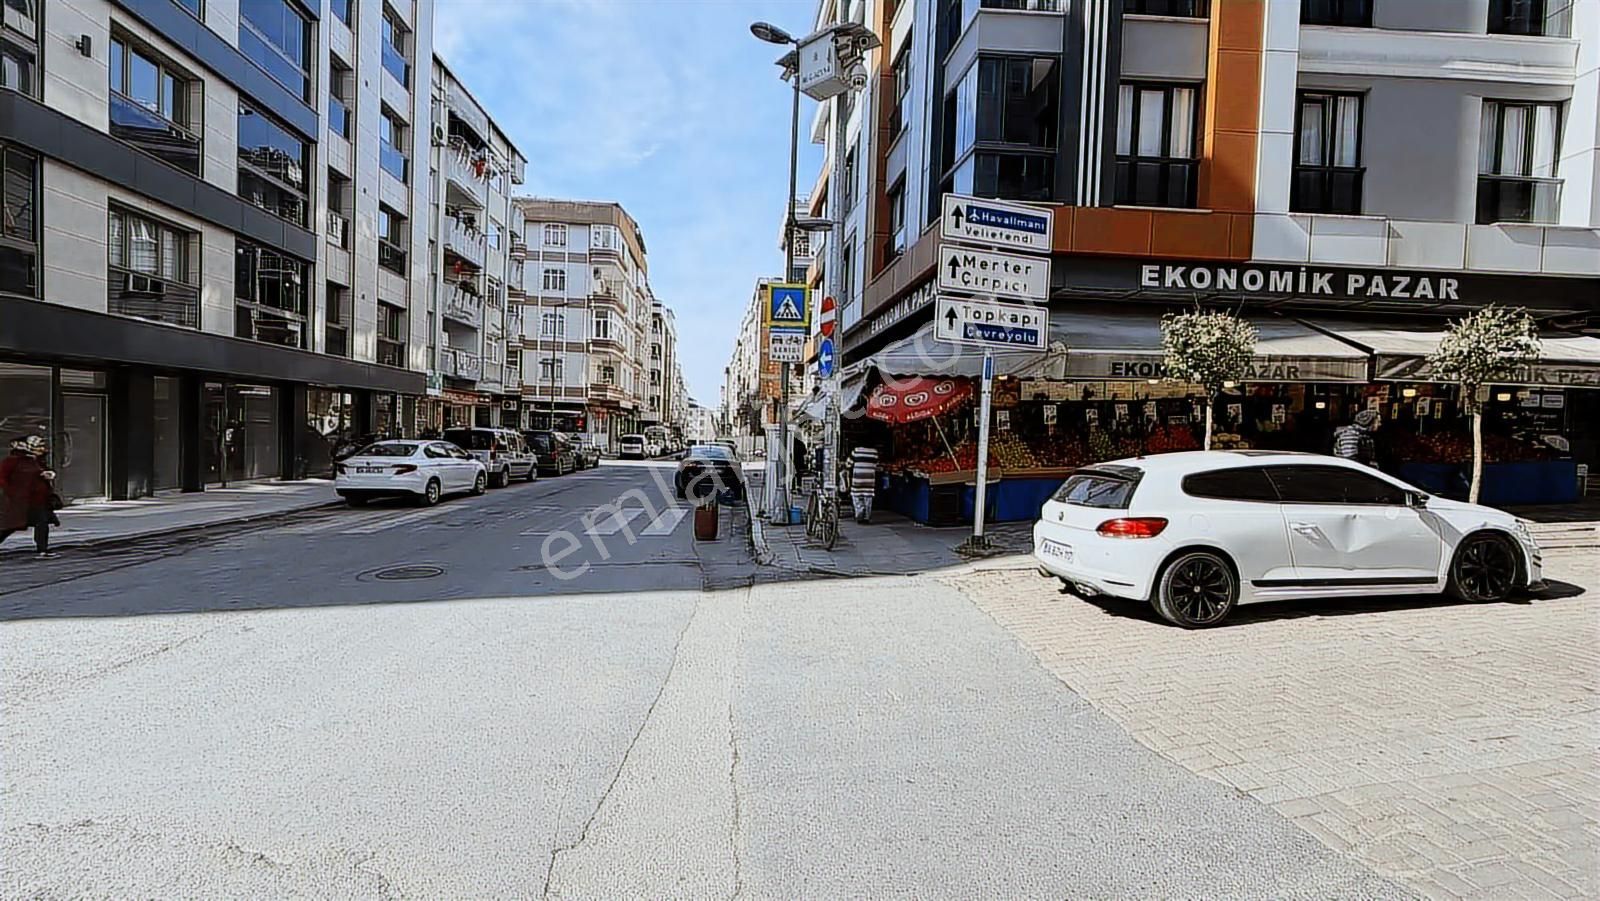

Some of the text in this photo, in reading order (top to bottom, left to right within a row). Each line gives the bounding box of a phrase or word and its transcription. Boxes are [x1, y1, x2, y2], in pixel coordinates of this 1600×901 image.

[962, 255, 1032, 275] Merter
[961, 271, 1029, 292] Çırpıcı
[1140, 266, 1461, 300] EKONOMİK PAZAR
[911, 278, 937, 310] PAZA
[963, 305, 1038, 327] Topkapı
[965, 325, 1036, 343] Çevreyolu
[1111, 361, 1300, 379] EKON AZAR
